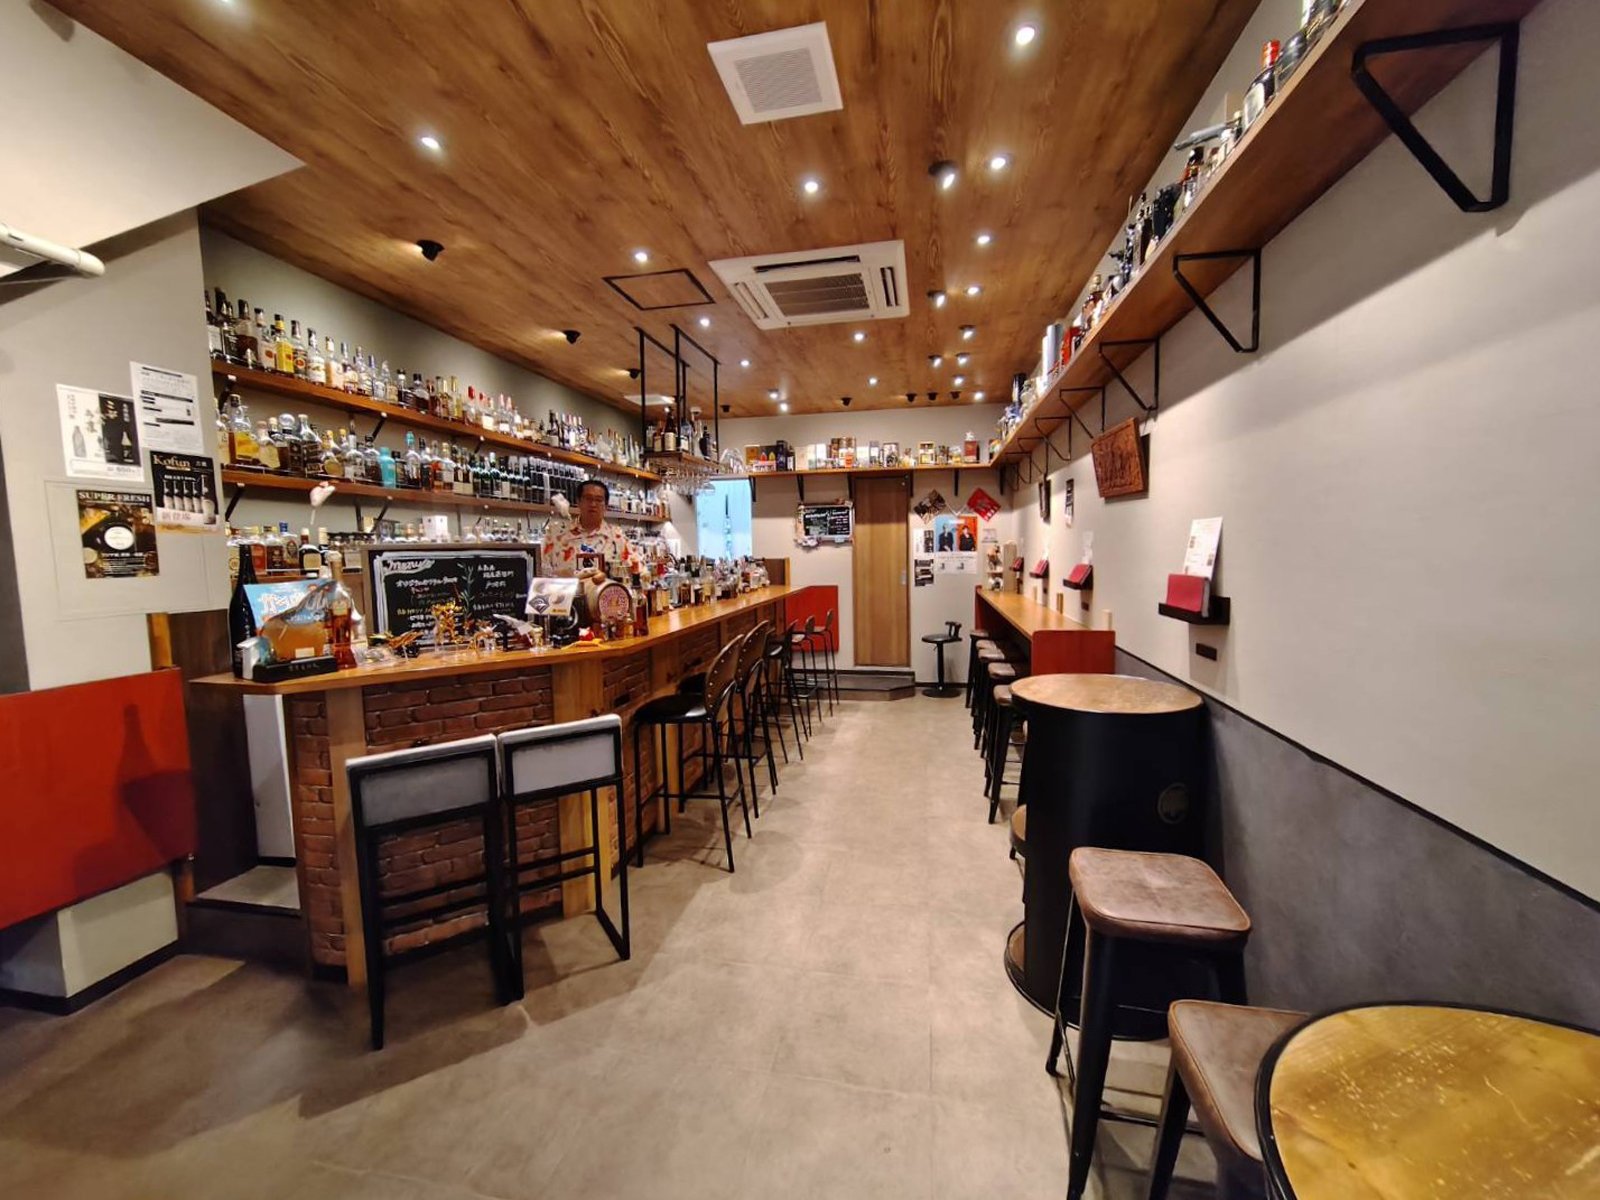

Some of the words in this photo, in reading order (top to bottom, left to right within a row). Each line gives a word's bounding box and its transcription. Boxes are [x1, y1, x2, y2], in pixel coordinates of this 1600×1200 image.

[153, 454, 191, 468] Kofun
[78, 491, 116, 501] SUPER
[116, 494, 151, 503] FRESH
